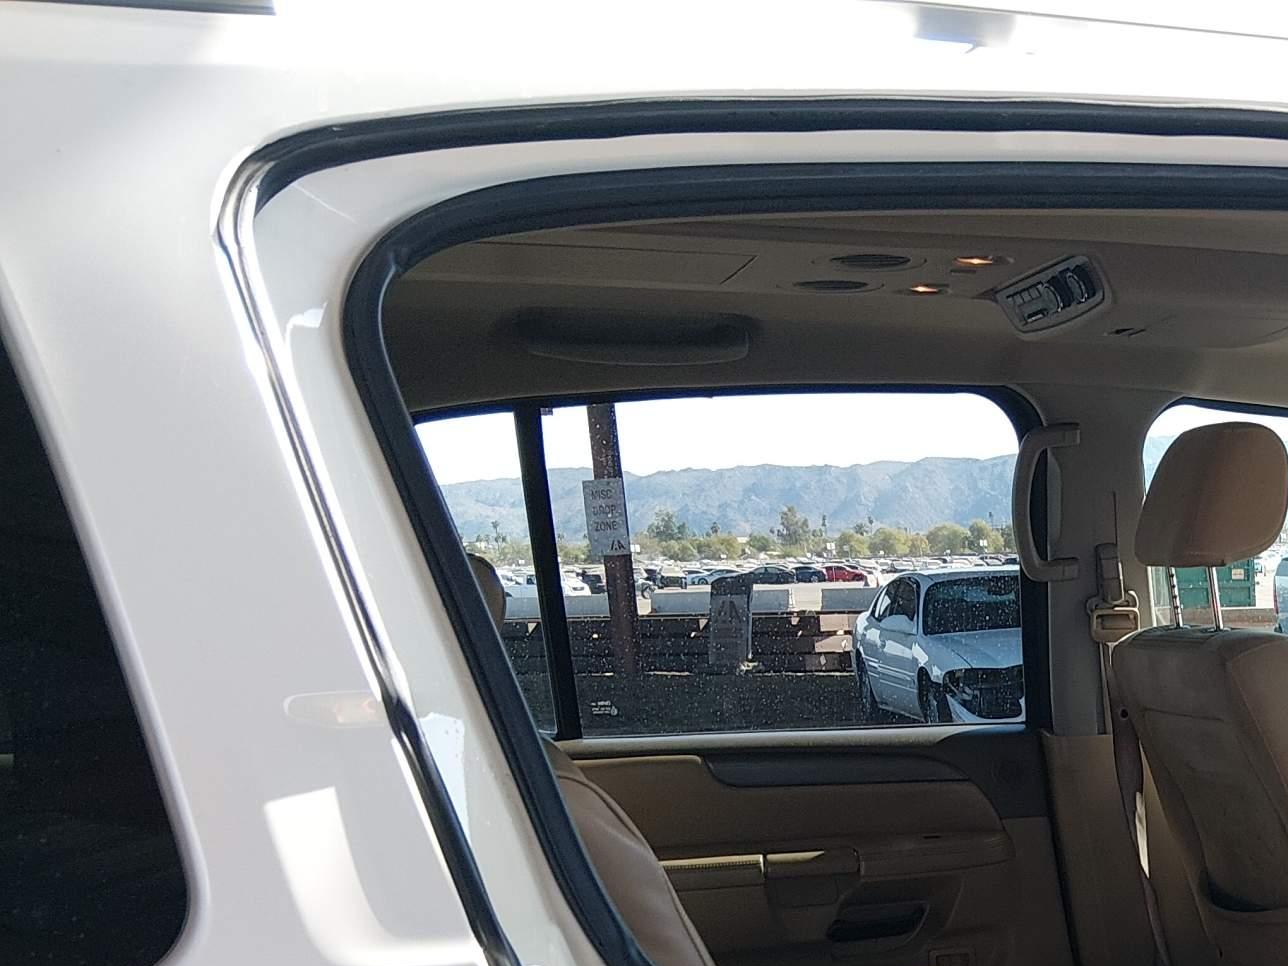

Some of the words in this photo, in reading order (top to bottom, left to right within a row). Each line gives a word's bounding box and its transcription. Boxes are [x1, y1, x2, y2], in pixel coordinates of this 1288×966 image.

[591, 488, 612, 500] MISC
[592, 504, 616, 516] DROP
[594, 520, 617, 532] ZONE
